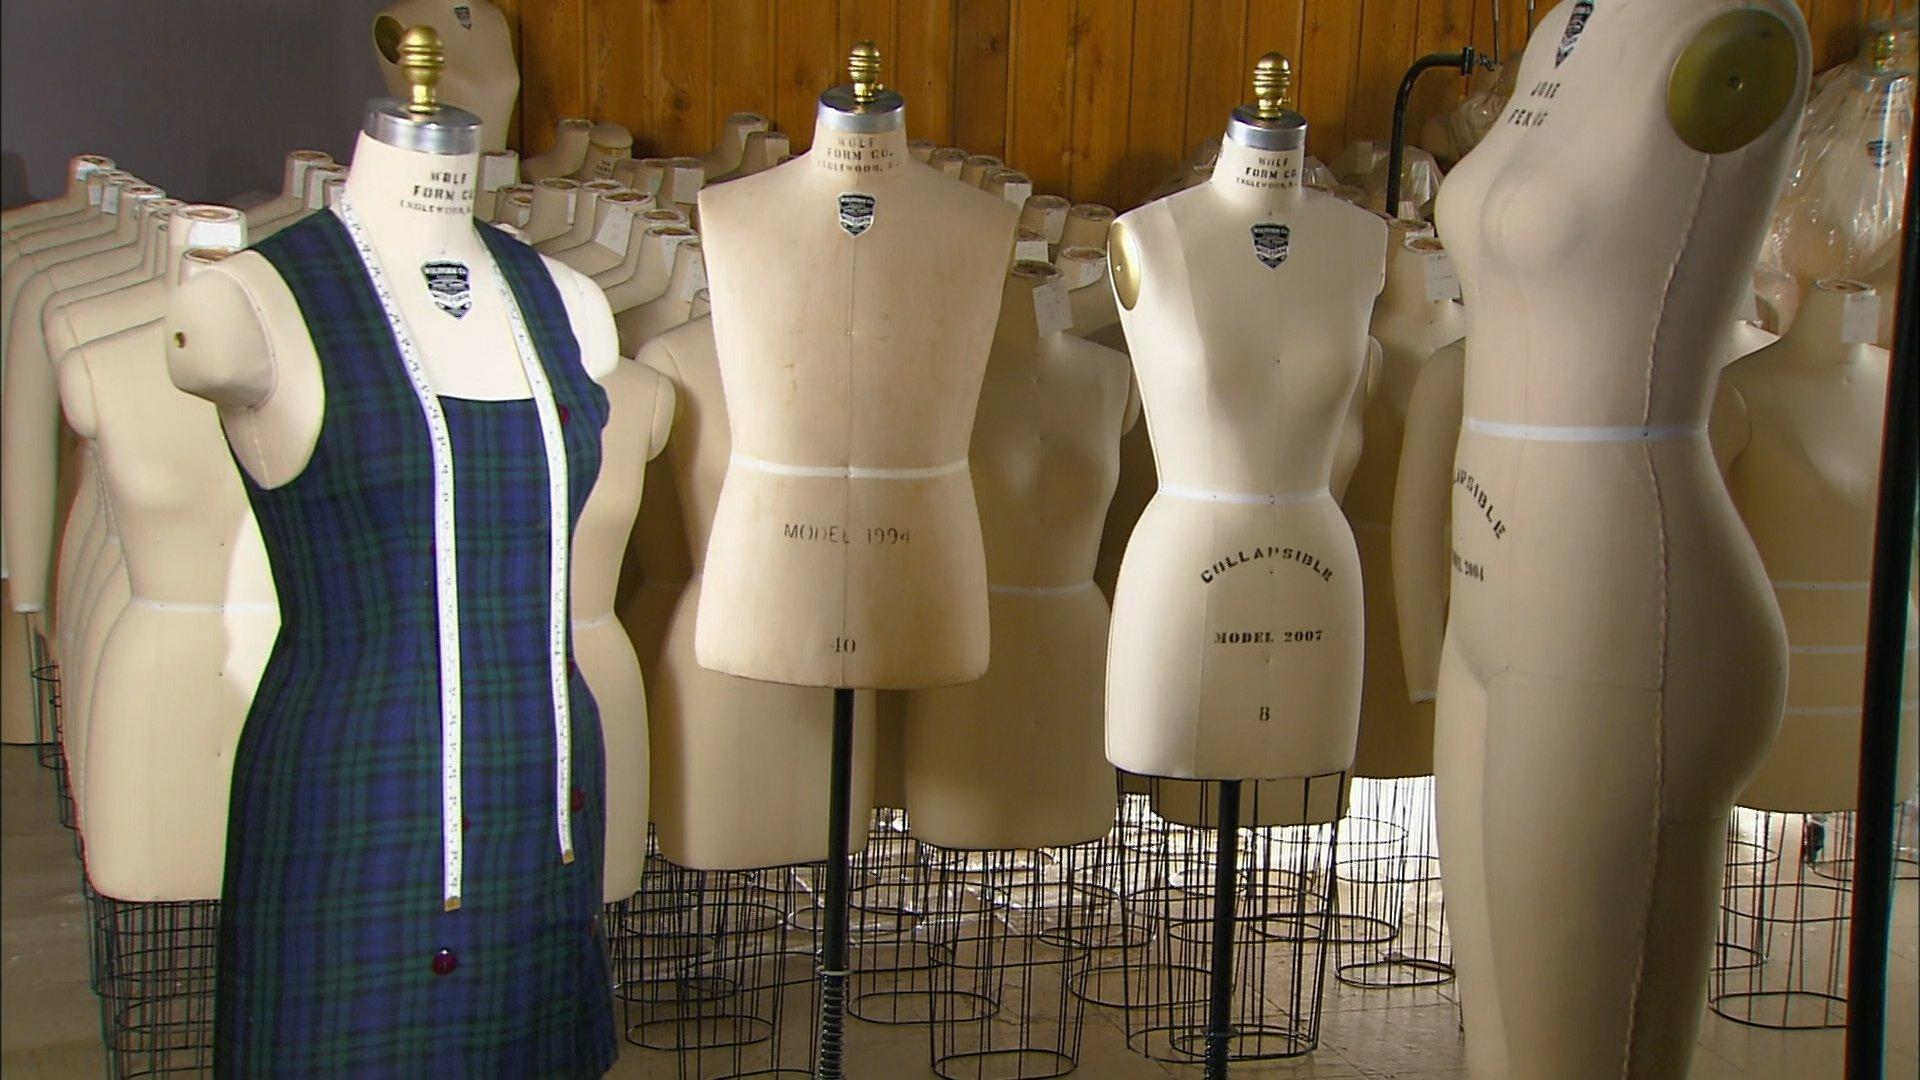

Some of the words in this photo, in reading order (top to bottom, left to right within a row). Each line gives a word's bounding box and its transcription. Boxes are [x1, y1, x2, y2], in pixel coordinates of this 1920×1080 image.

[827, 147, 862, 160] FORM
[1245, 167, 1278, 179] FORM
[412, 185, 455, 200] FORM
[784, 523, 850, 544] MODEL
[867, 527, 911, 545] 1994
[1200, 546, 1334, 585] COLLAPSIBLE
[830, 636, 857, 653] 40
[1214, 631, 1275, 644] MODEL
[1283, 629, 1324, 643] 2007
[1258, 705, 1270, 722] 8
